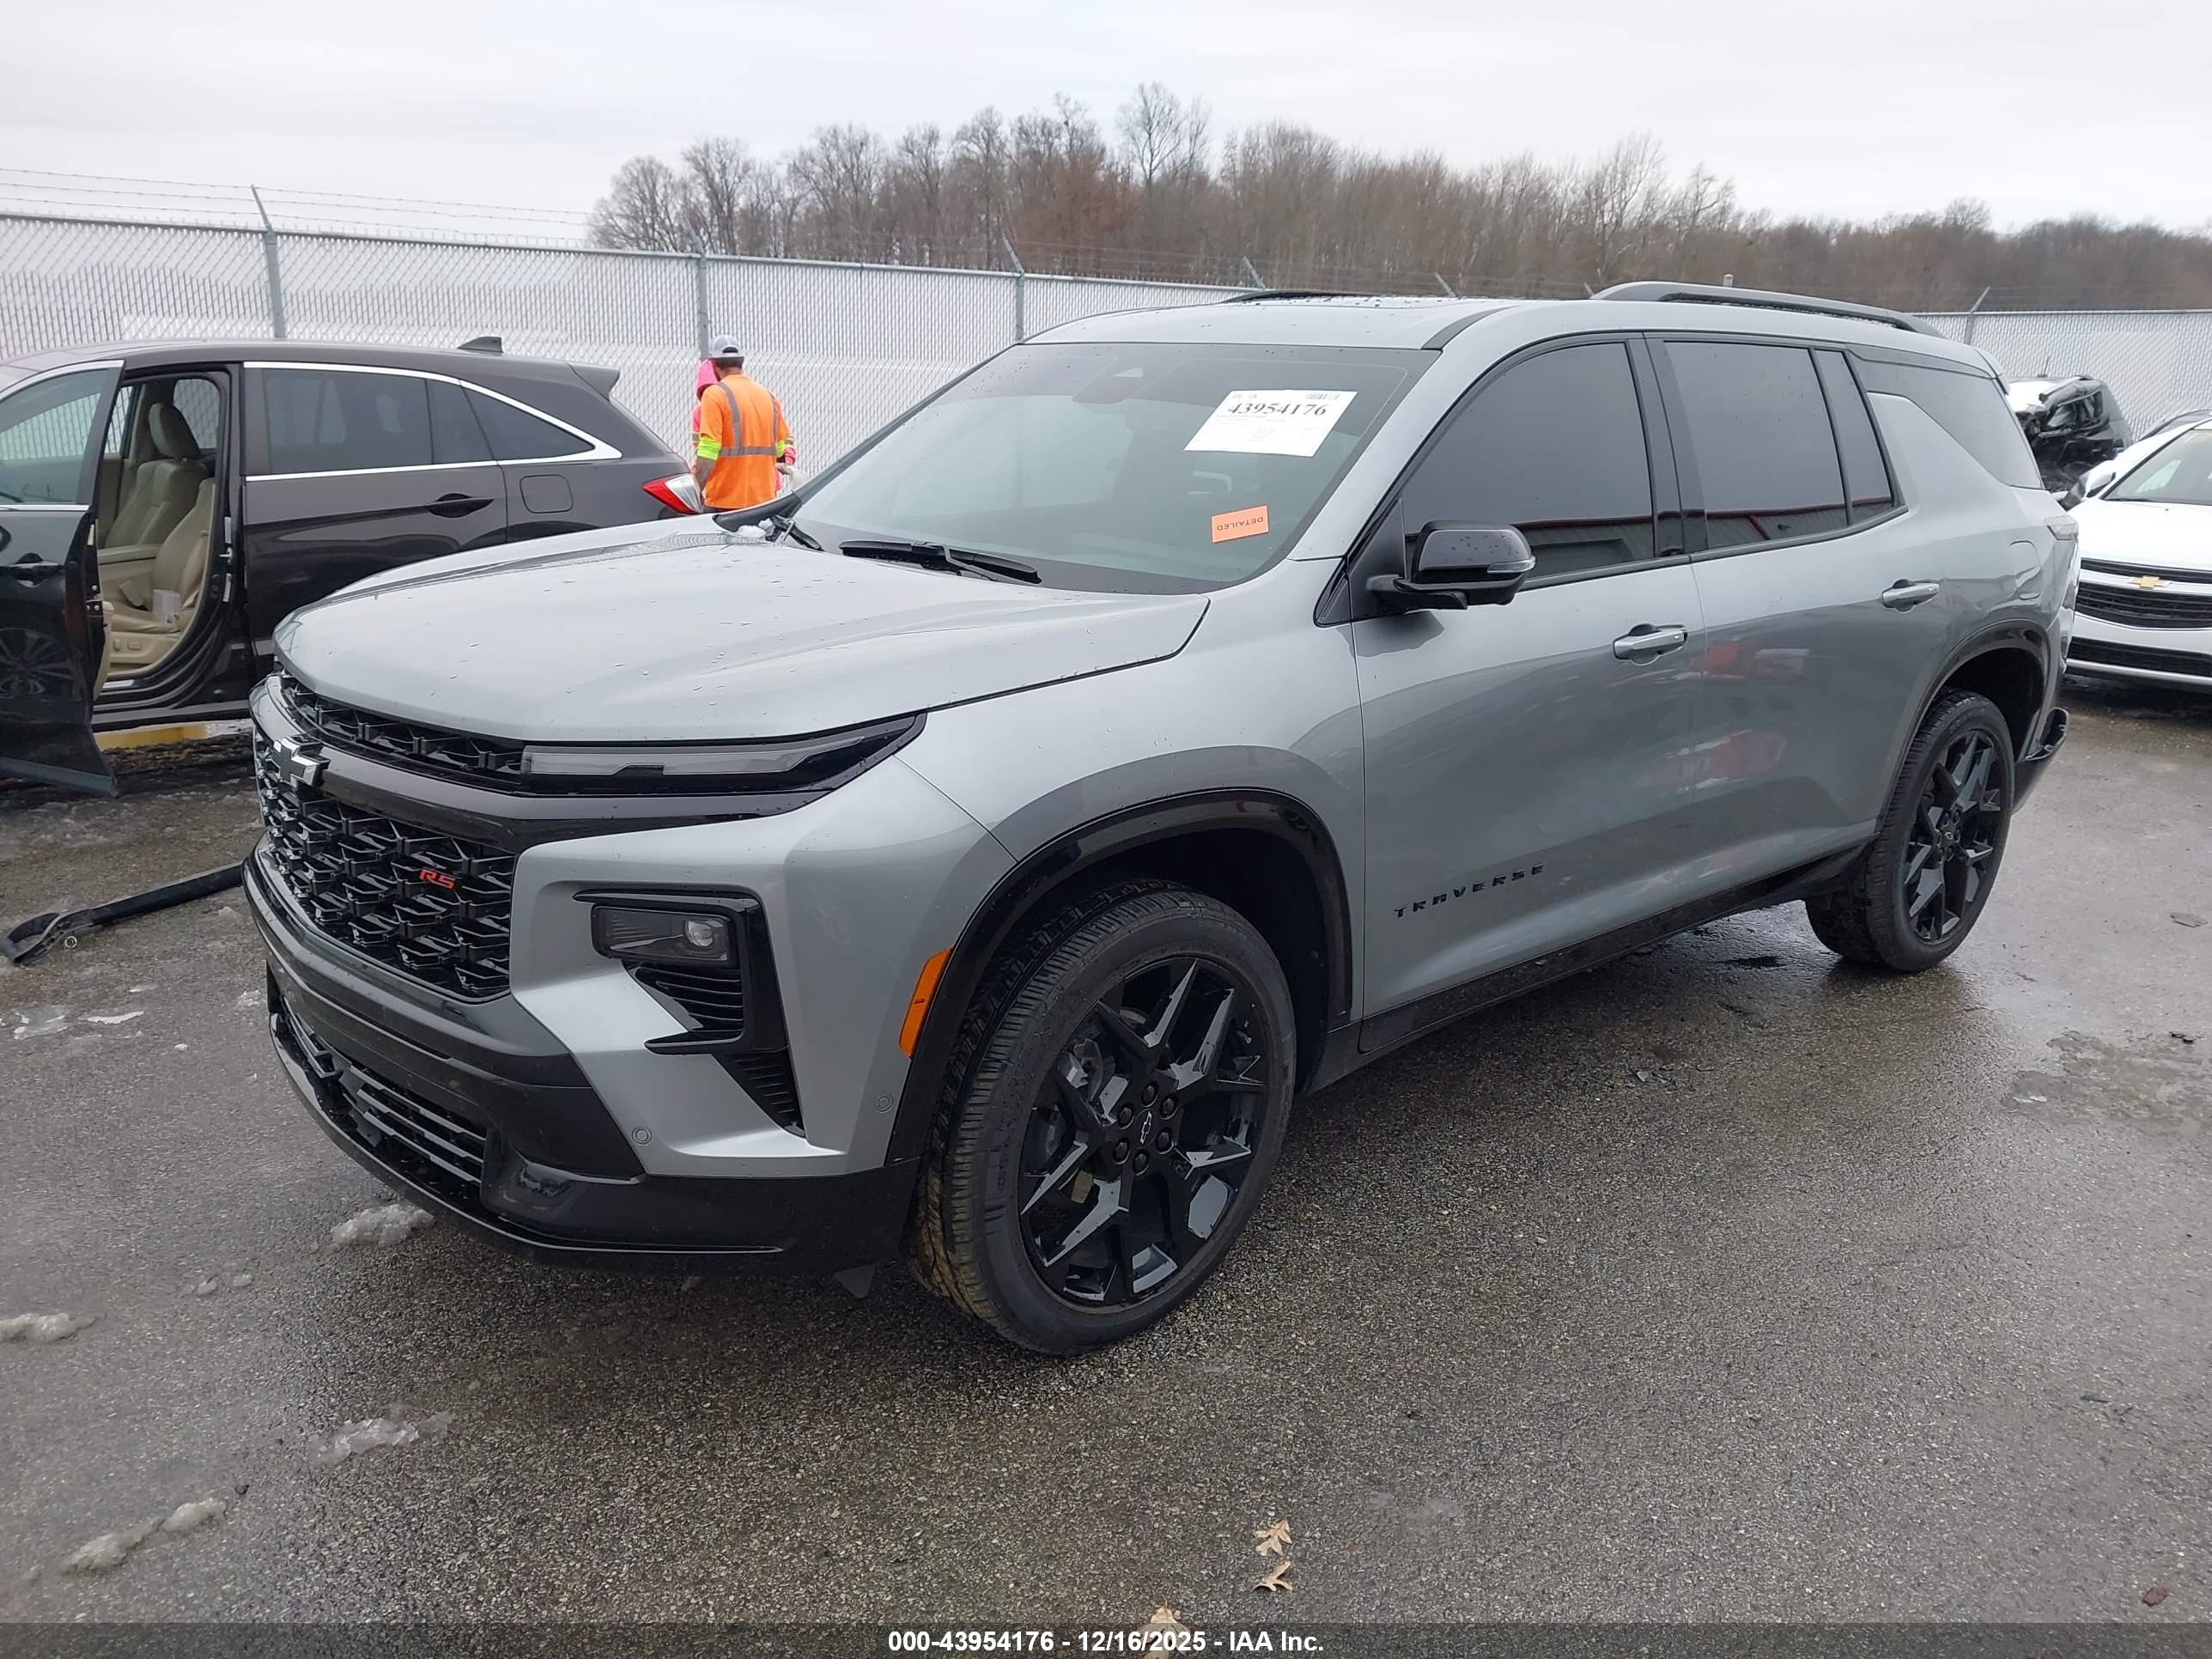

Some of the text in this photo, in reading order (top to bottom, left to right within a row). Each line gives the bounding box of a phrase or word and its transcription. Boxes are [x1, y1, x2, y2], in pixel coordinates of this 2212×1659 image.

[1228, 403, 1328, 416] 43954176
[1217, 517, 1264, 531] DETAILED
[418, 868, 455, 890] RS
[1394, 863, 1546, 918] TRAVERSE
